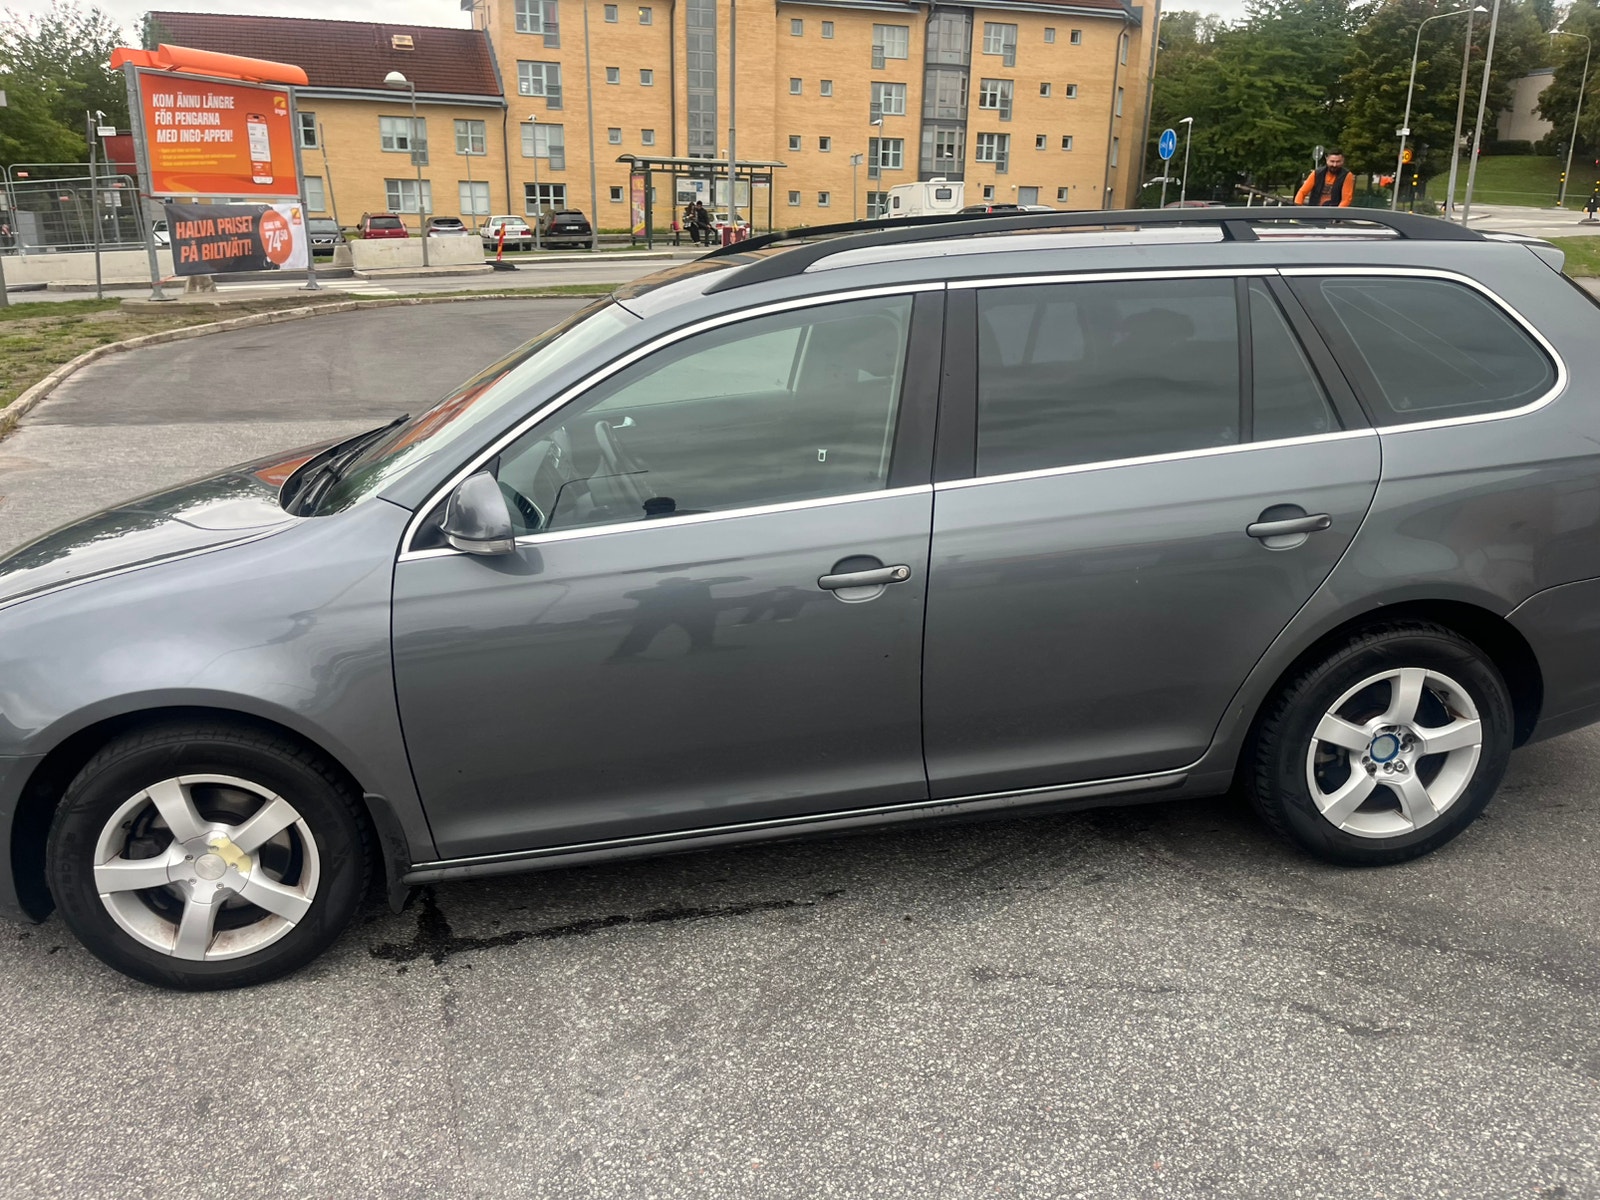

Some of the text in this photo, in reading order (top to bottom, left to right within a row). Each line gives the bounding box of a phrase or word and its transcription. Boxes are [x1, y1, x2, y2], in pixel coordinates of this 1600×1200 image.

[152, 91, 235, 109] KOM ÄNNU LÄNGRE
[154, 109, 221, 126] FÖR PENGARNA
[156, 129, 234, 143] MED INGO-APPEN!
[175, 218, 216, 239] HALVA
[217, 215, 254, 235] PRISET
[180, 237, 252, 263] PÅ BILTVÄTT!
